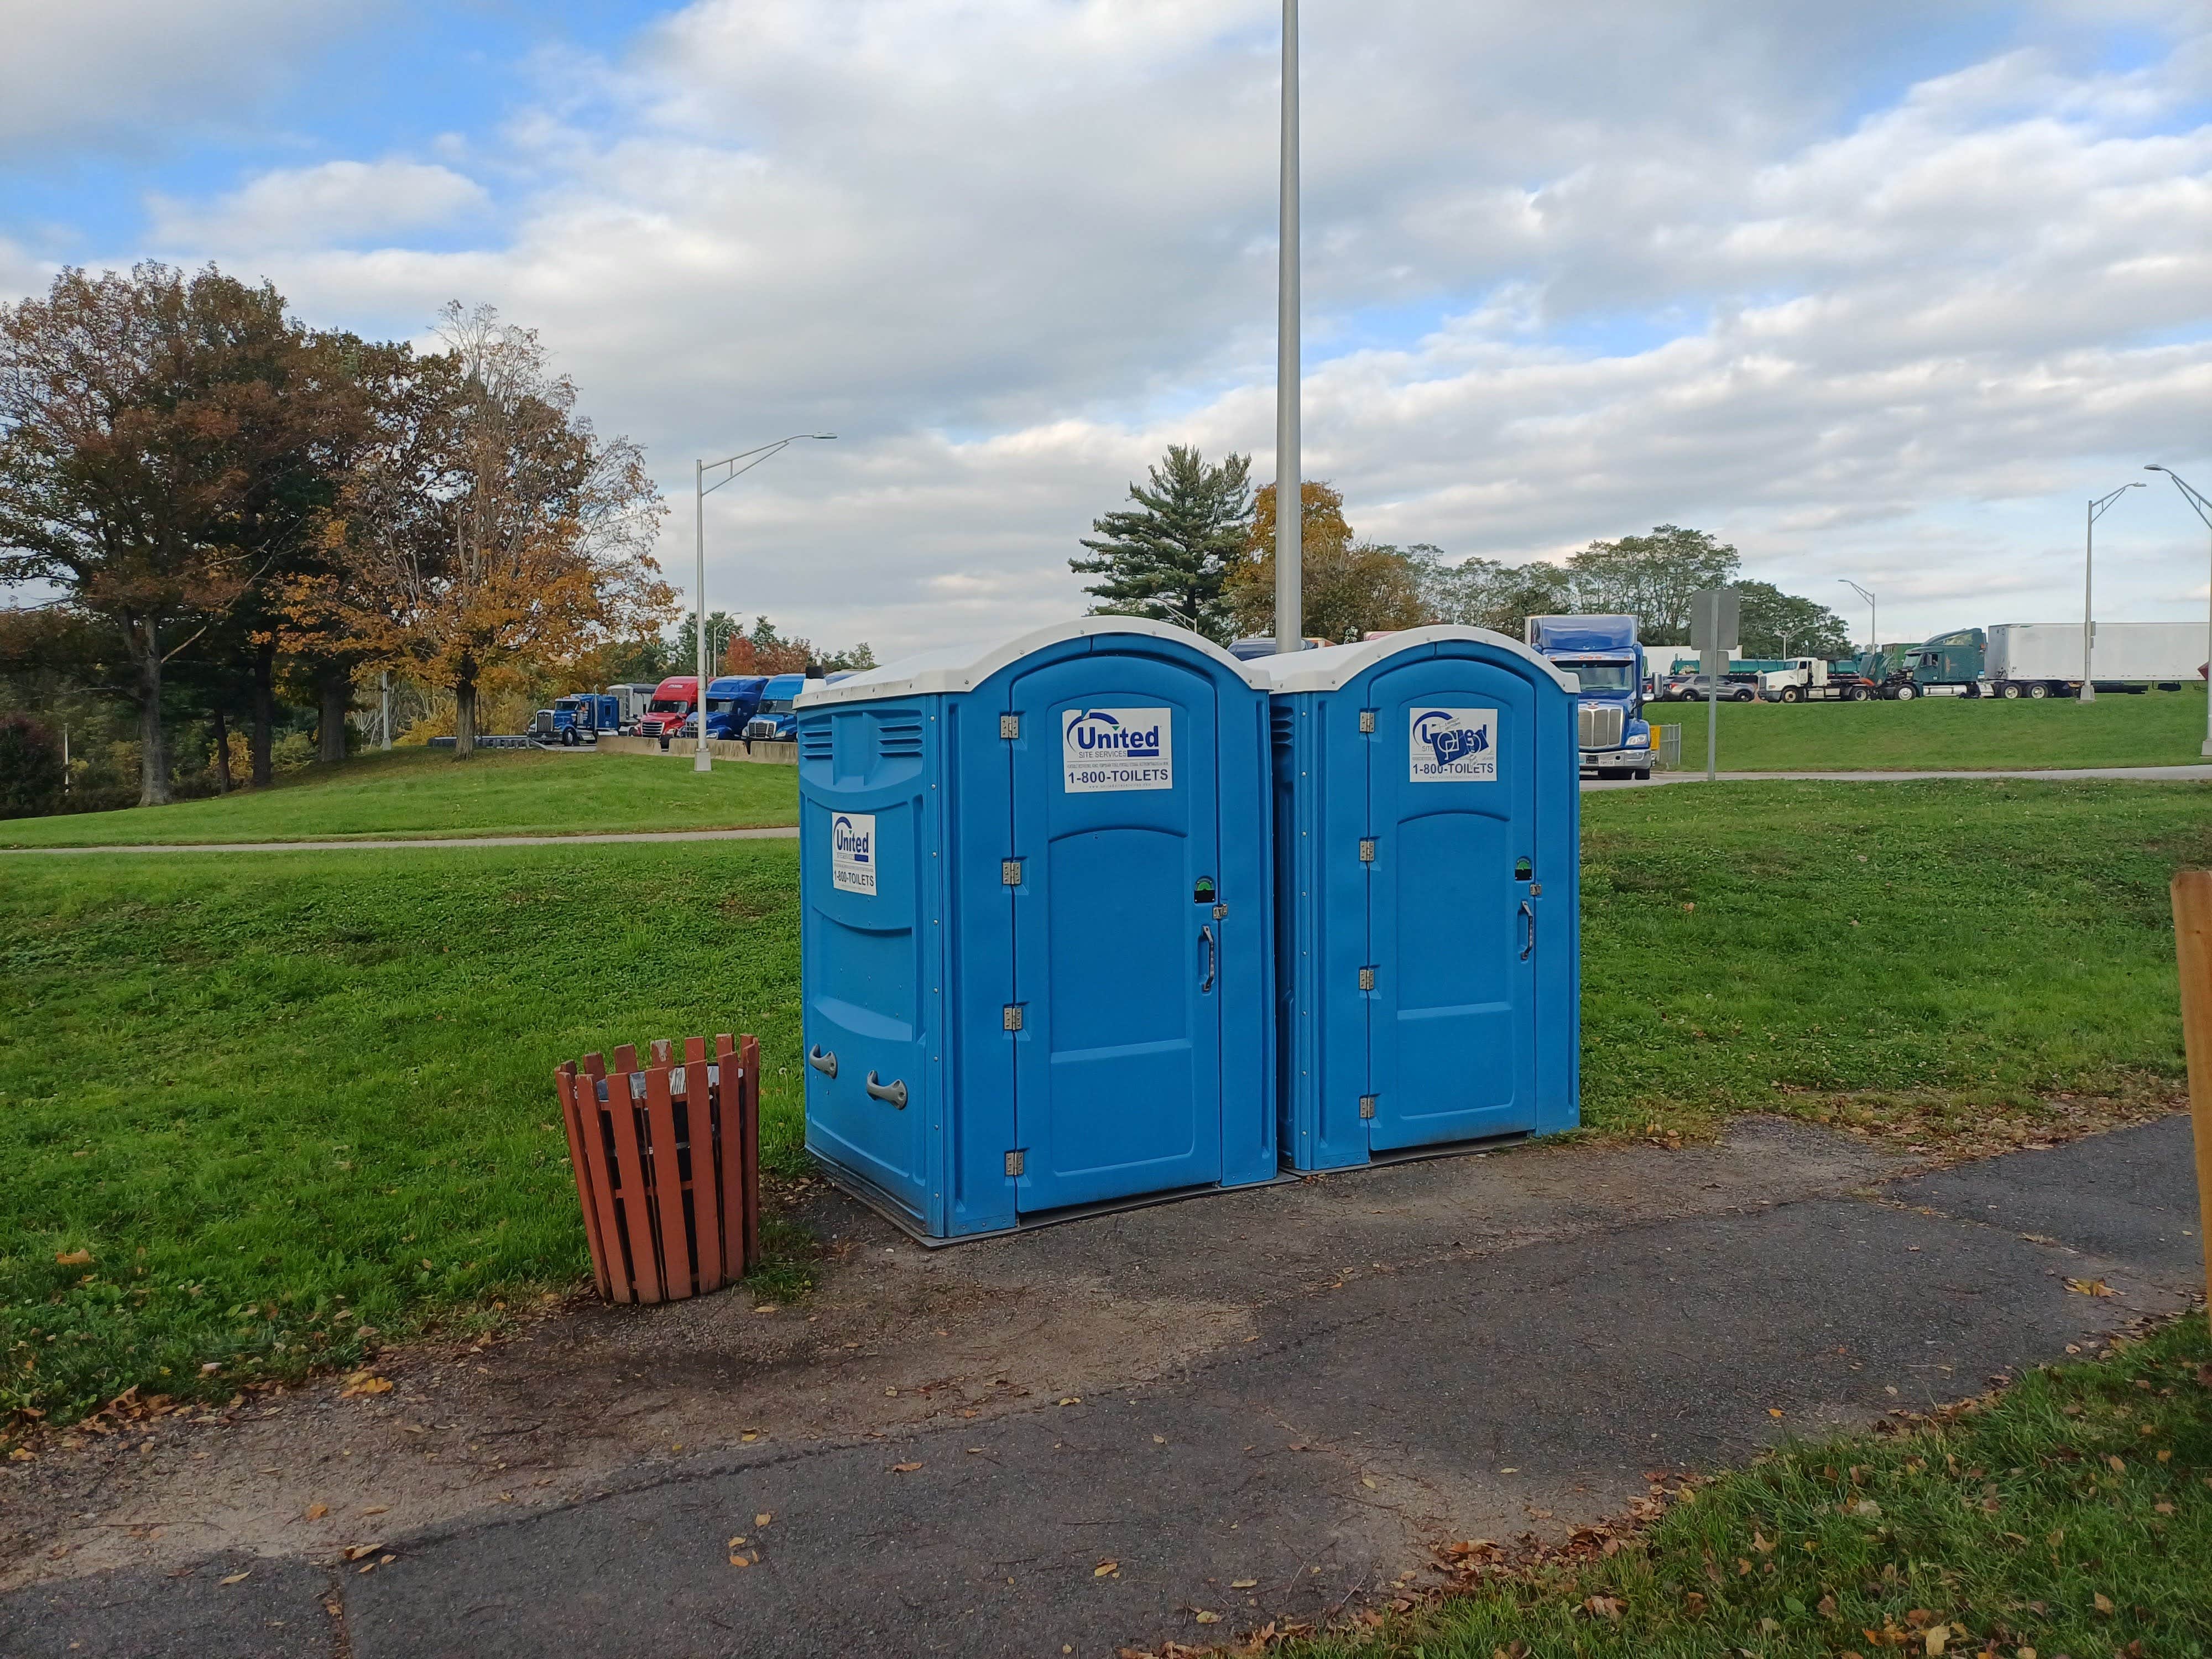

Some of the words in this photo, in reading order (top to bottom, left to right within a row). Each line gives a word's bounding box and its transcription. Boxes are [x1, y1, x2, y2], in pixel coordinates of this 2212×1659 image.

[1078, 726, 1159, 749] United
[1068, 769, 1168, 784] 1-800-TOILETS
[1413, 763, 1494, 774] 1-800-TOILETS
[837, 829, 869, 853] United
[834, 870, 874, 886] 1-800-TOILETS
